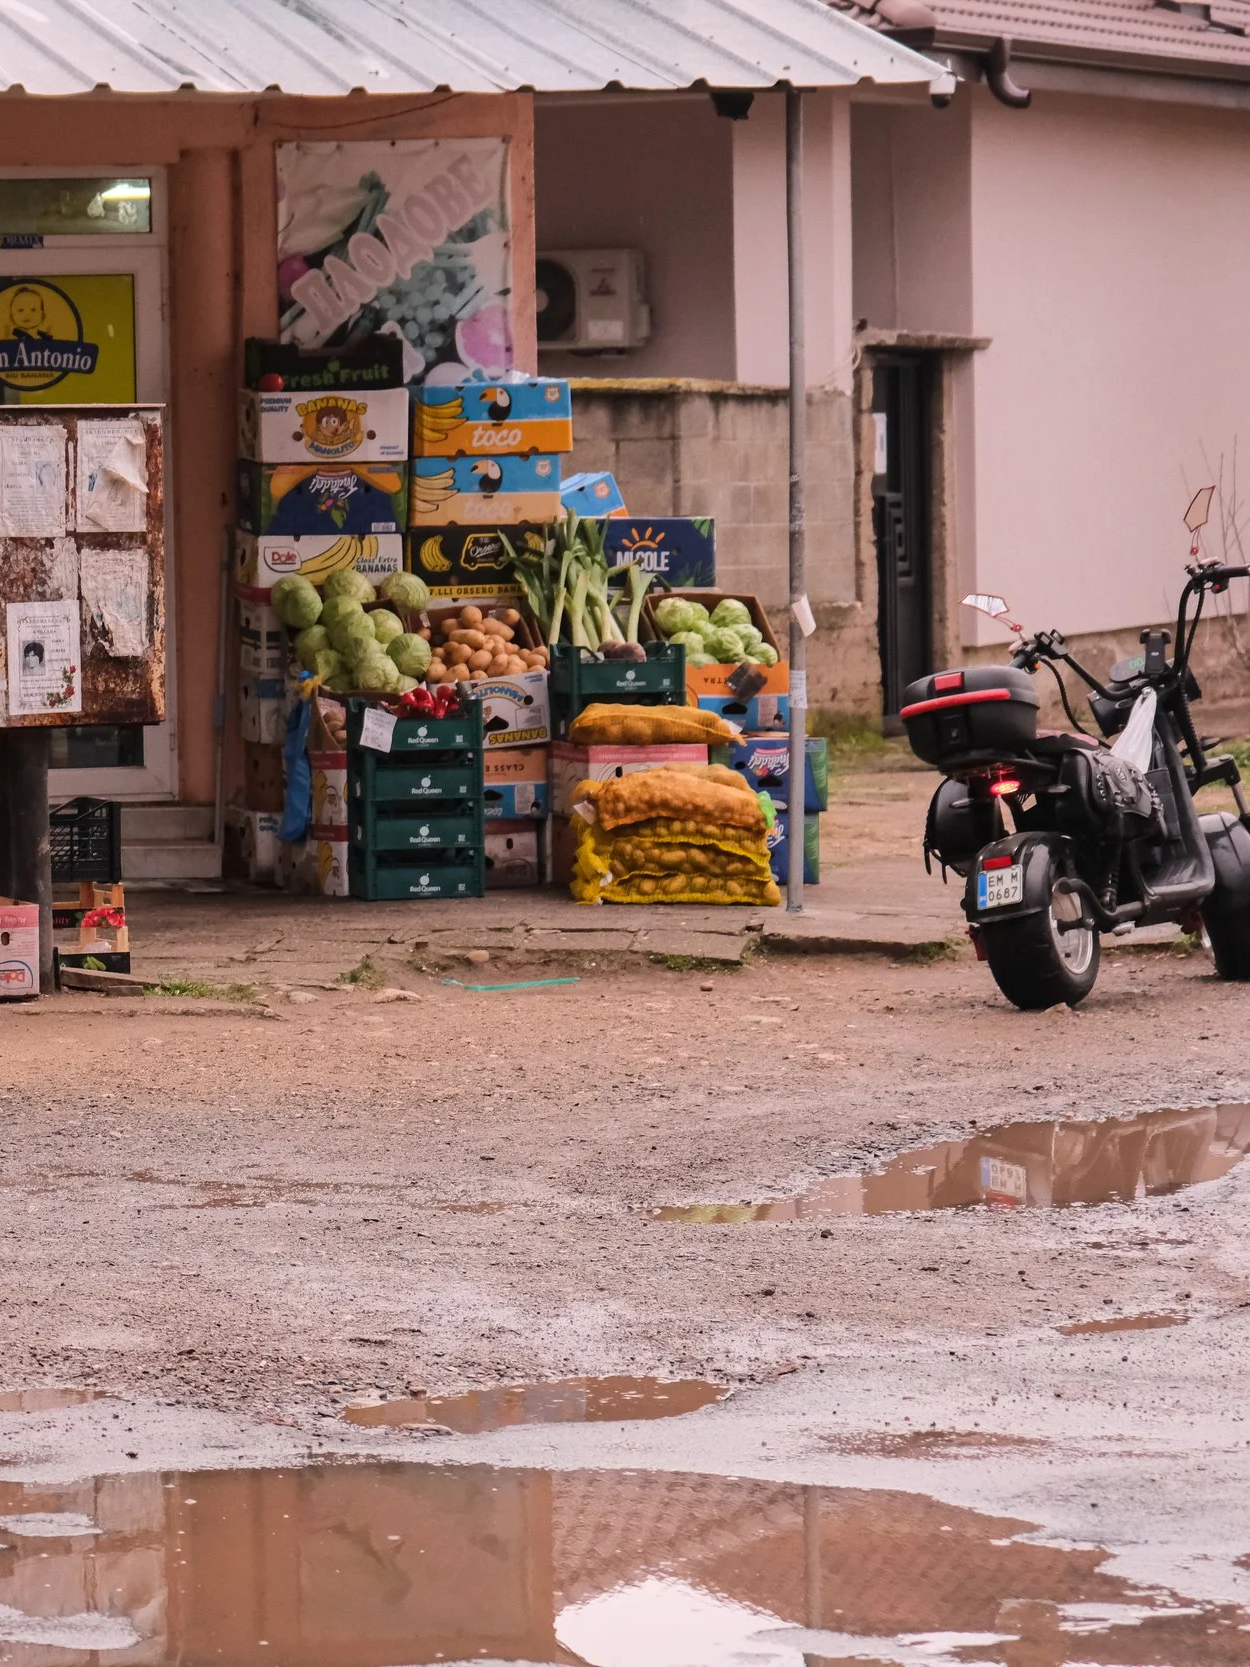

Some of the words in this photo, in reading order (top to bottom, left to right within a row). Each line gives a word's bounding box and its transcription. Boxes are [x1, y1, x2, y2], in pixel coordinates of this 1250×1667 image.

[15, 342, 92, 371] Antonio
[5, 371, 19, 379] BIG
[20, 371, 54, 379] BANANA
[340, 361, 390, 384] Fruit
[295, 396, 368, 418] BANANAS
[471, 427, 523, 448] toco
[463, 498, 513, 518] toco
[271, 551, 297, 562] Dole
[637, 551, 670, 571] COLE
[356, 564, 398, 573] BANANAS
[457, 585, 495, 595] ORSERO
[487, 726, 548, 744] BANANAS
[988, 874, 1004, 889] EM
[1011, 871, 1018, 883] M
[988, 886, 1018, 902] 0687
[0, 970, 26, 983] Dole
